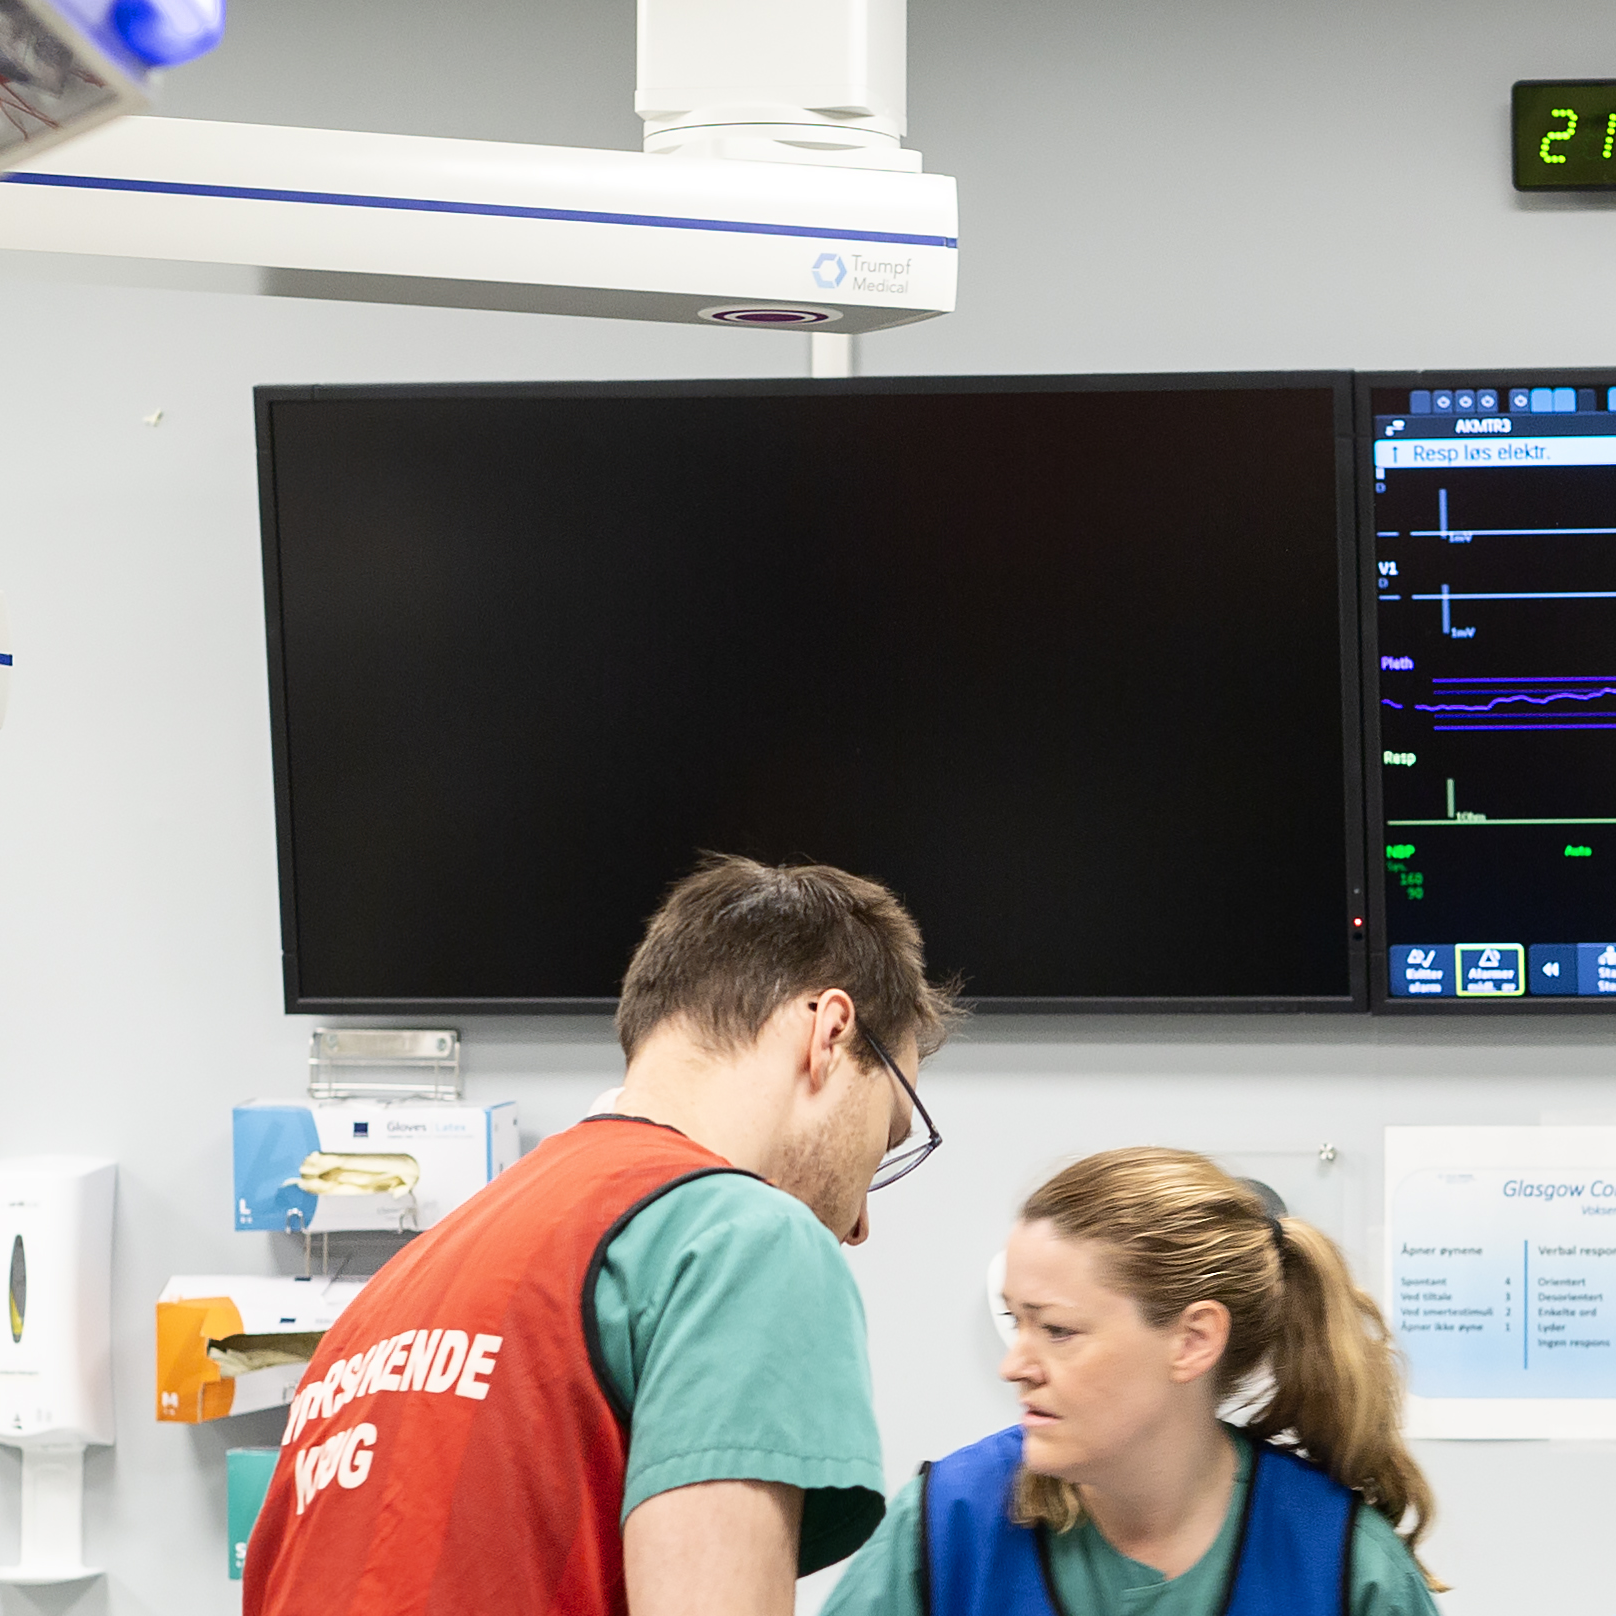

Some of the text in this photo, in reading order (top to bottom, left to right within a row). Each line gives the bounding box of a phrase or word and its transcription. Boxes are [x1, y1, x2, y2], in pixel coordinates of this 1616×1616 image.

[852, 254, 912, 277] Trumpf
[852, 277, 908, 294] Medical
[1413, 444, 1551, 466] Resp løs elektr.
[387, 1121, 466, 1133] Gloves Latex
[1503, 1180, 1585, 1201] Glasgow
[239, 1198, 252, 1215] L
[161, 1391, 179, 1408] M
